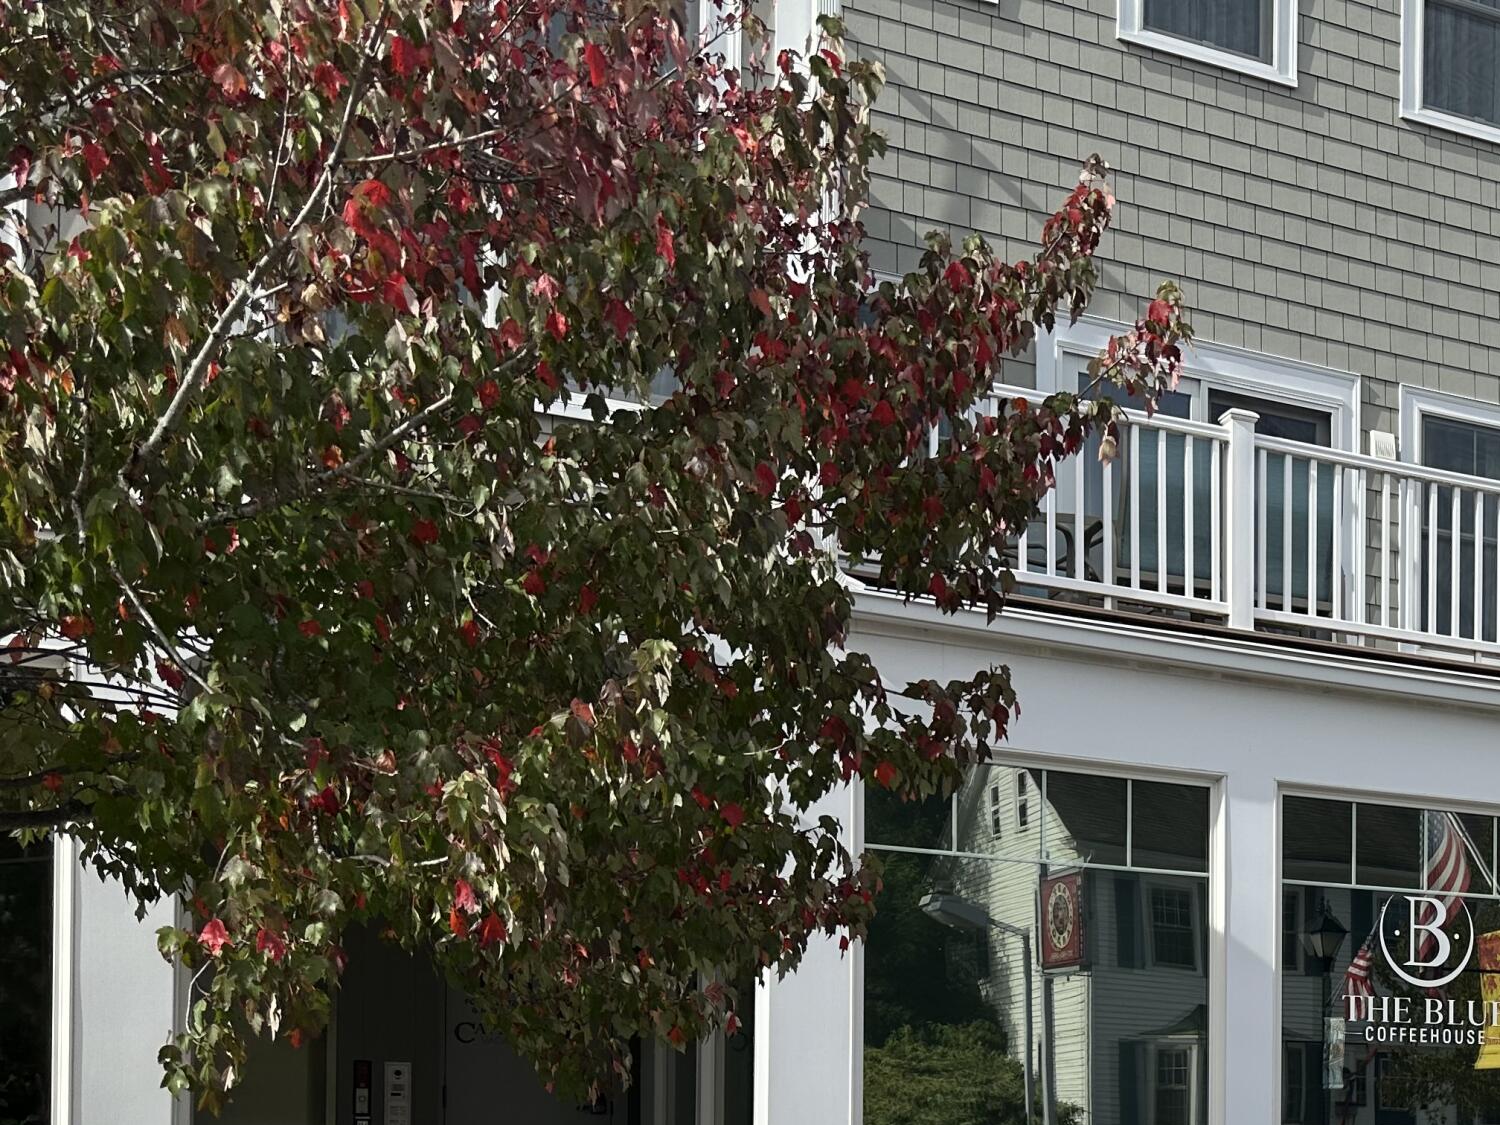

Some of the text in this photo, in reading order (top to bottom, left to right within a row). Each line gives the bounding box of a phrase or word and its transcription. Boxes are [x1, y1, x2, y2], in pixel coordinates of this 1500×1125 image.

[1403, 895, 1450, 967] B
[1342, 994, 1411, 1024] THE
[1365, 1026, 1486, 1045] COFFEEHOUSE
